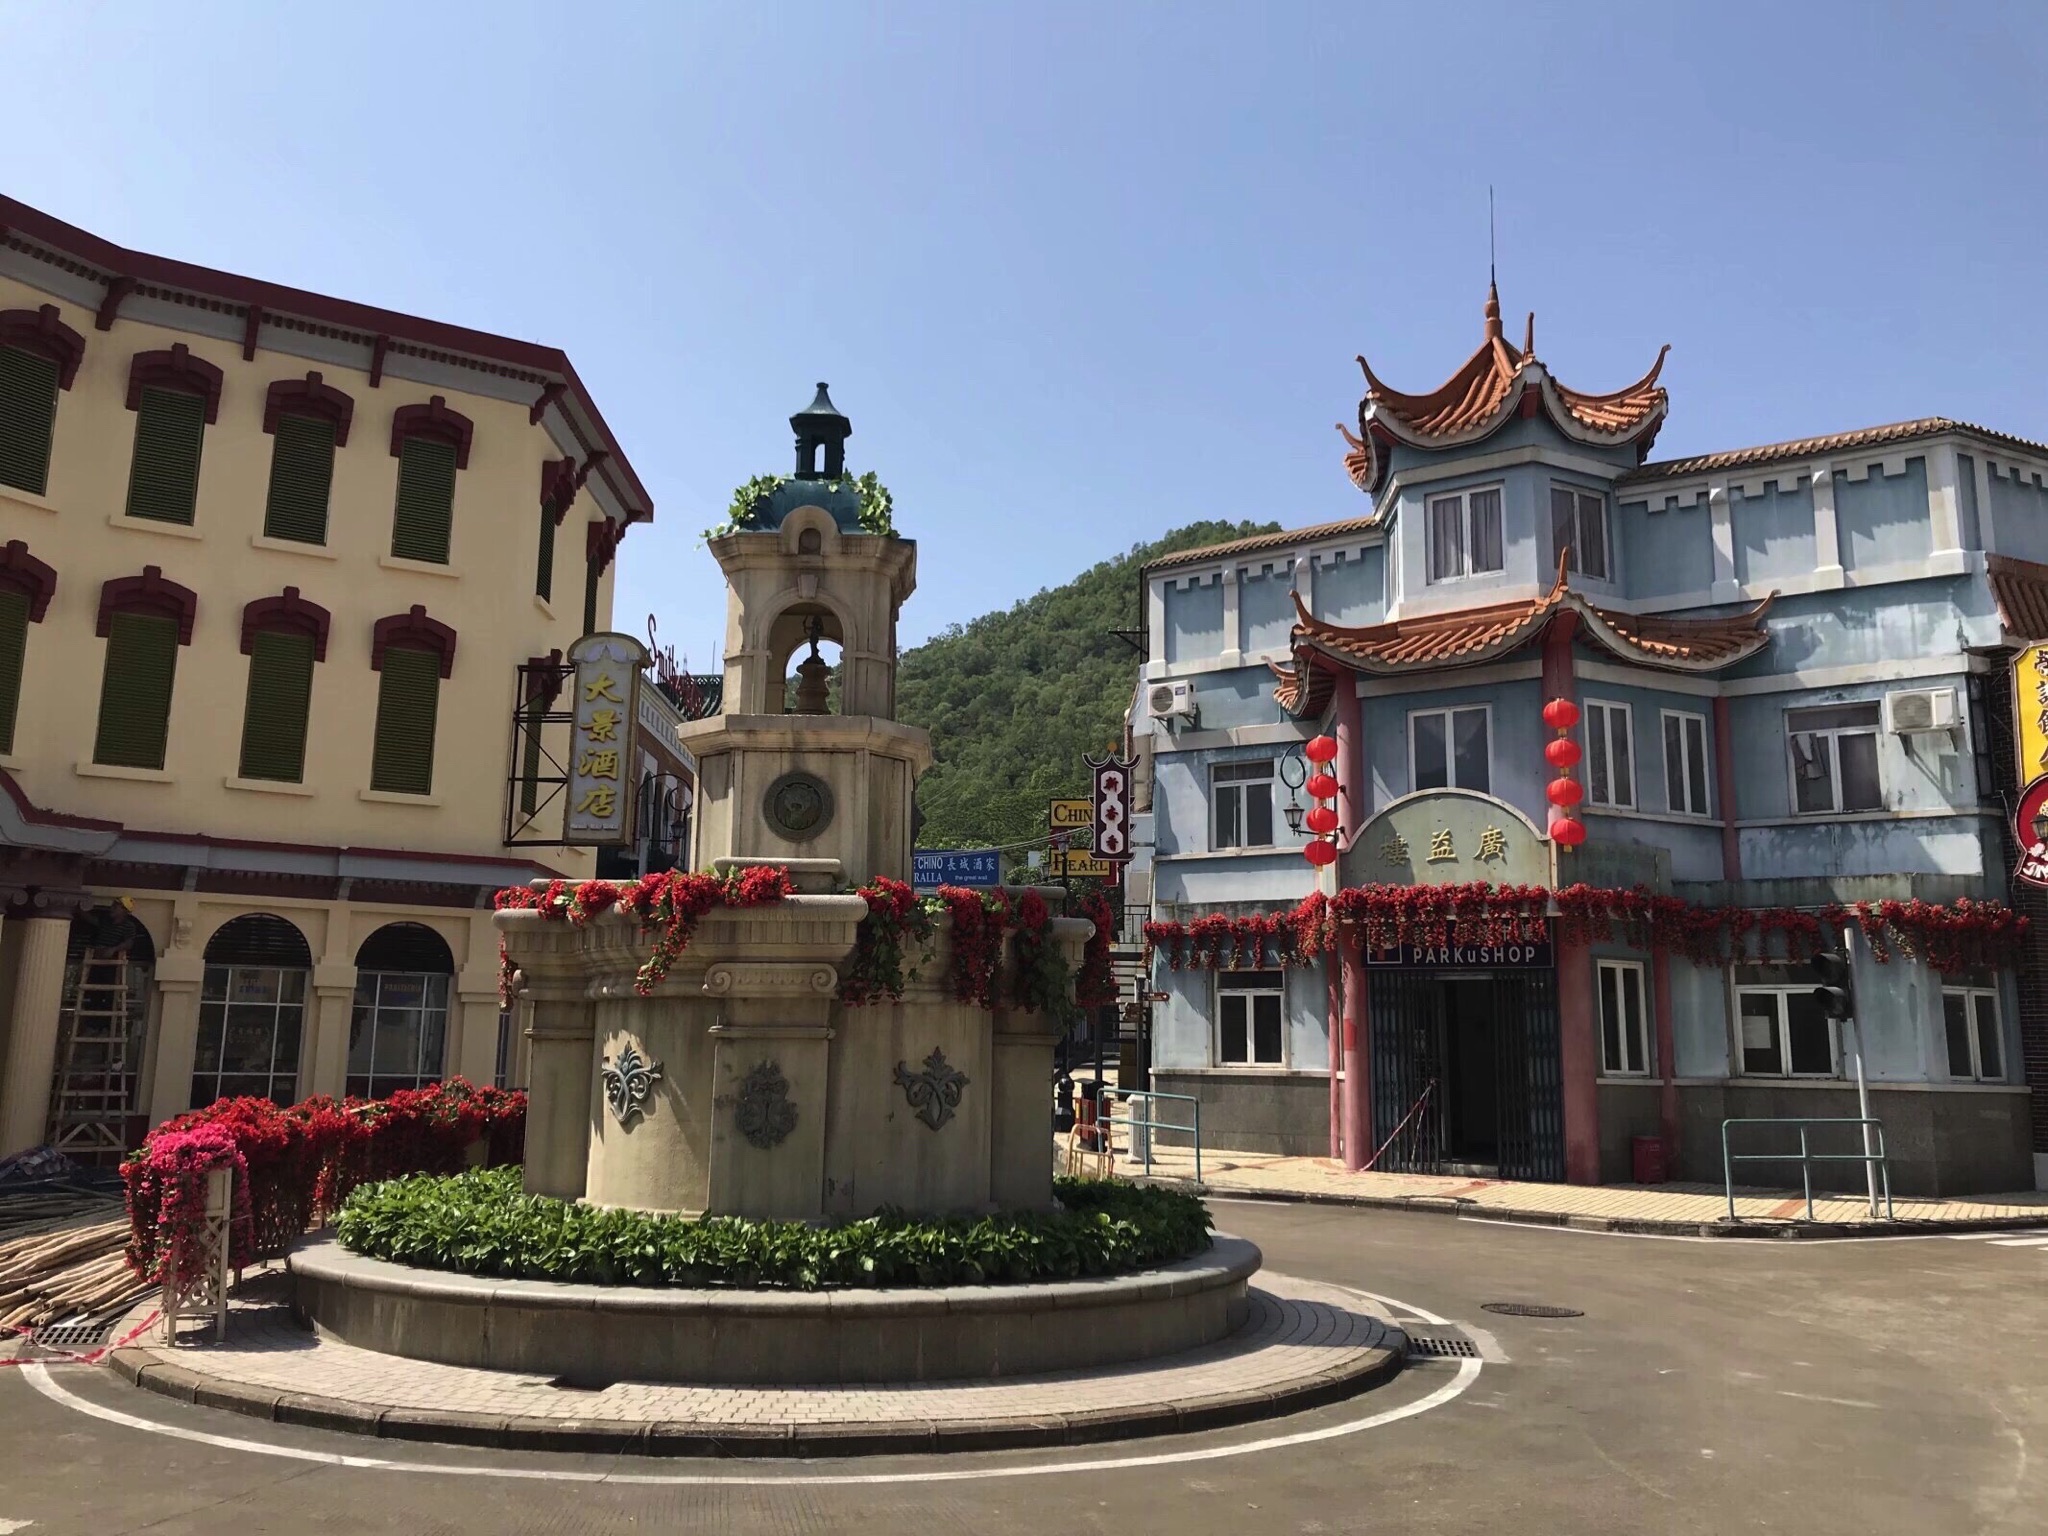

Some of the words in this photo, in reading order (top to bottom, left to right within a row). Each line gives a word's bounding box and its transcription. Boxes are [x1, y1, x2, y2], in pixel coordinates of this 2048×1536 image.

[577, 672, 623, 818] 大景酒店
[947, 857, 995, 871] 長城酒家
[1413, 946, 1536, 964] PARKuSHOP
